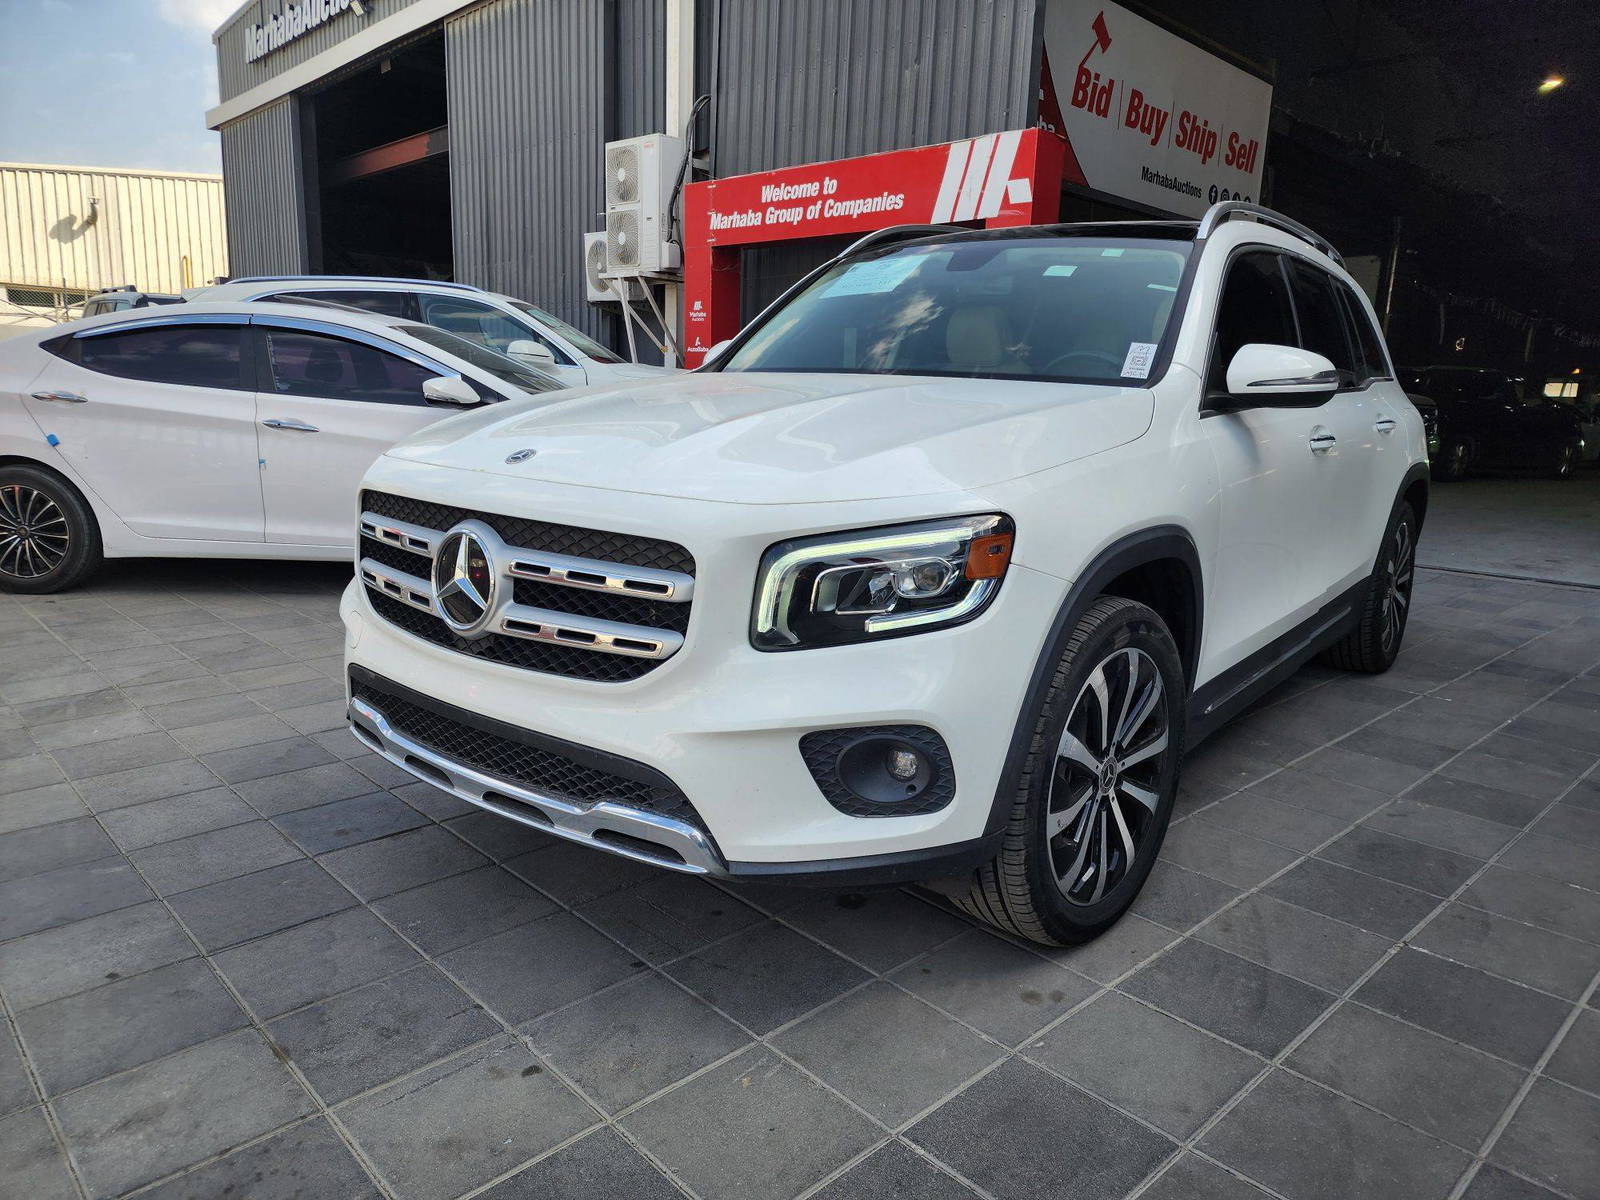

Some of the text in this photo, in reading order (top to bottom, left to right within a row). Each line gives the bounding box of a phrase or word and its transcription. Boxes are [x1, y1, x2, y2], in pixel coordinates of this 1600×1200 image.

[1071, 66, 1259, 173] Bid Buy Ship Sell
[761, 177, 838, 203] Welcome to
[1141, 166, 1202, 199] MarhabaAuctions
[709, 192, 905, 230] Marhaba Group of Companies
